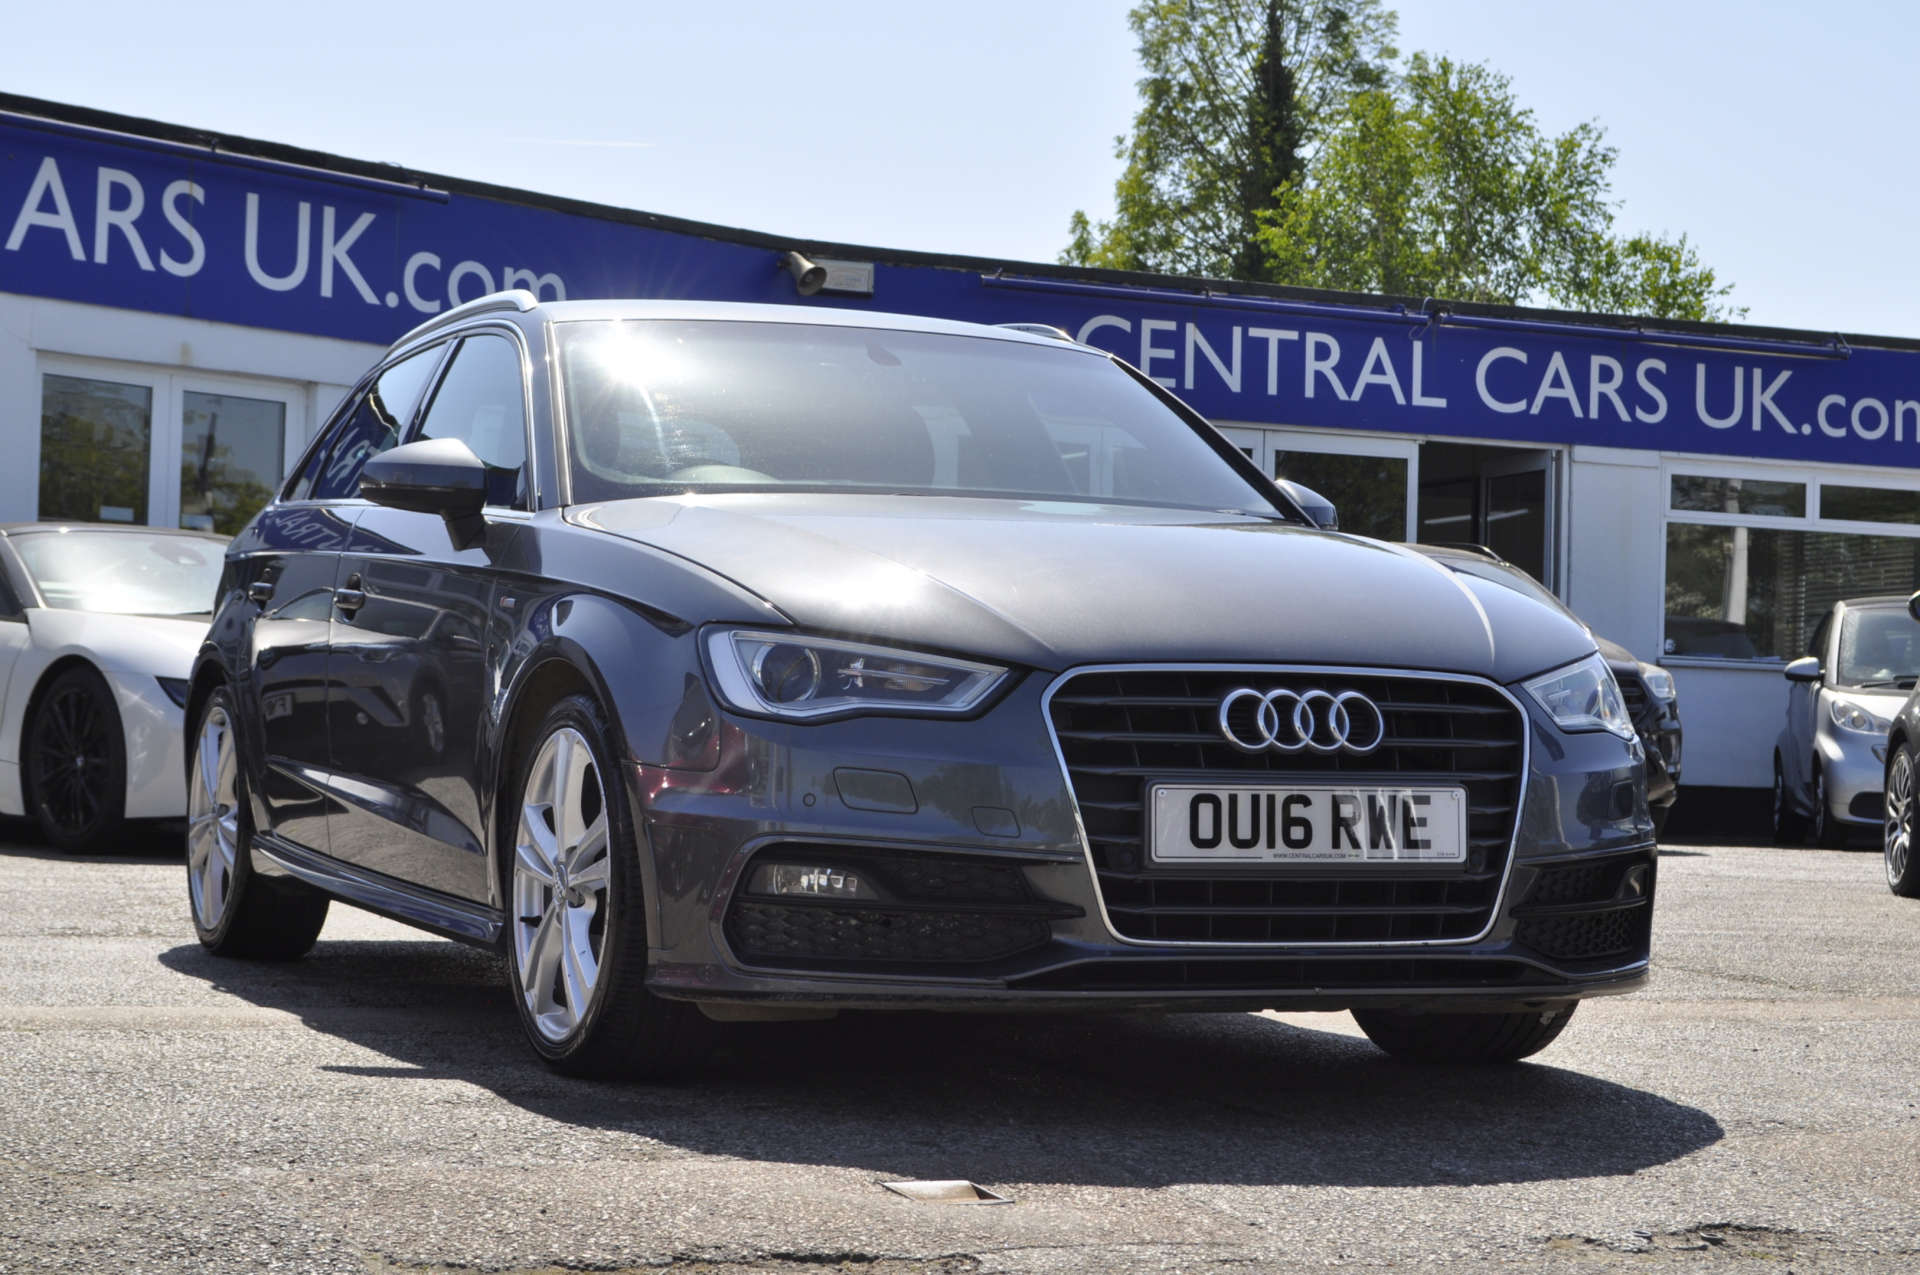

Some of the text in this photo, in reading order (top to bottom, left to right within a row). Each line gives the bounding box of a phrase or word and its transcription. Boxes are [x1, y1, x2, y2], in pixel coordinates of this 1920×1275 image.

[6, 157, 206, 277] ARS
[1475, 346, 1669, 424] CARS
[1189, 792, 1432, 850] OU16 RWE
